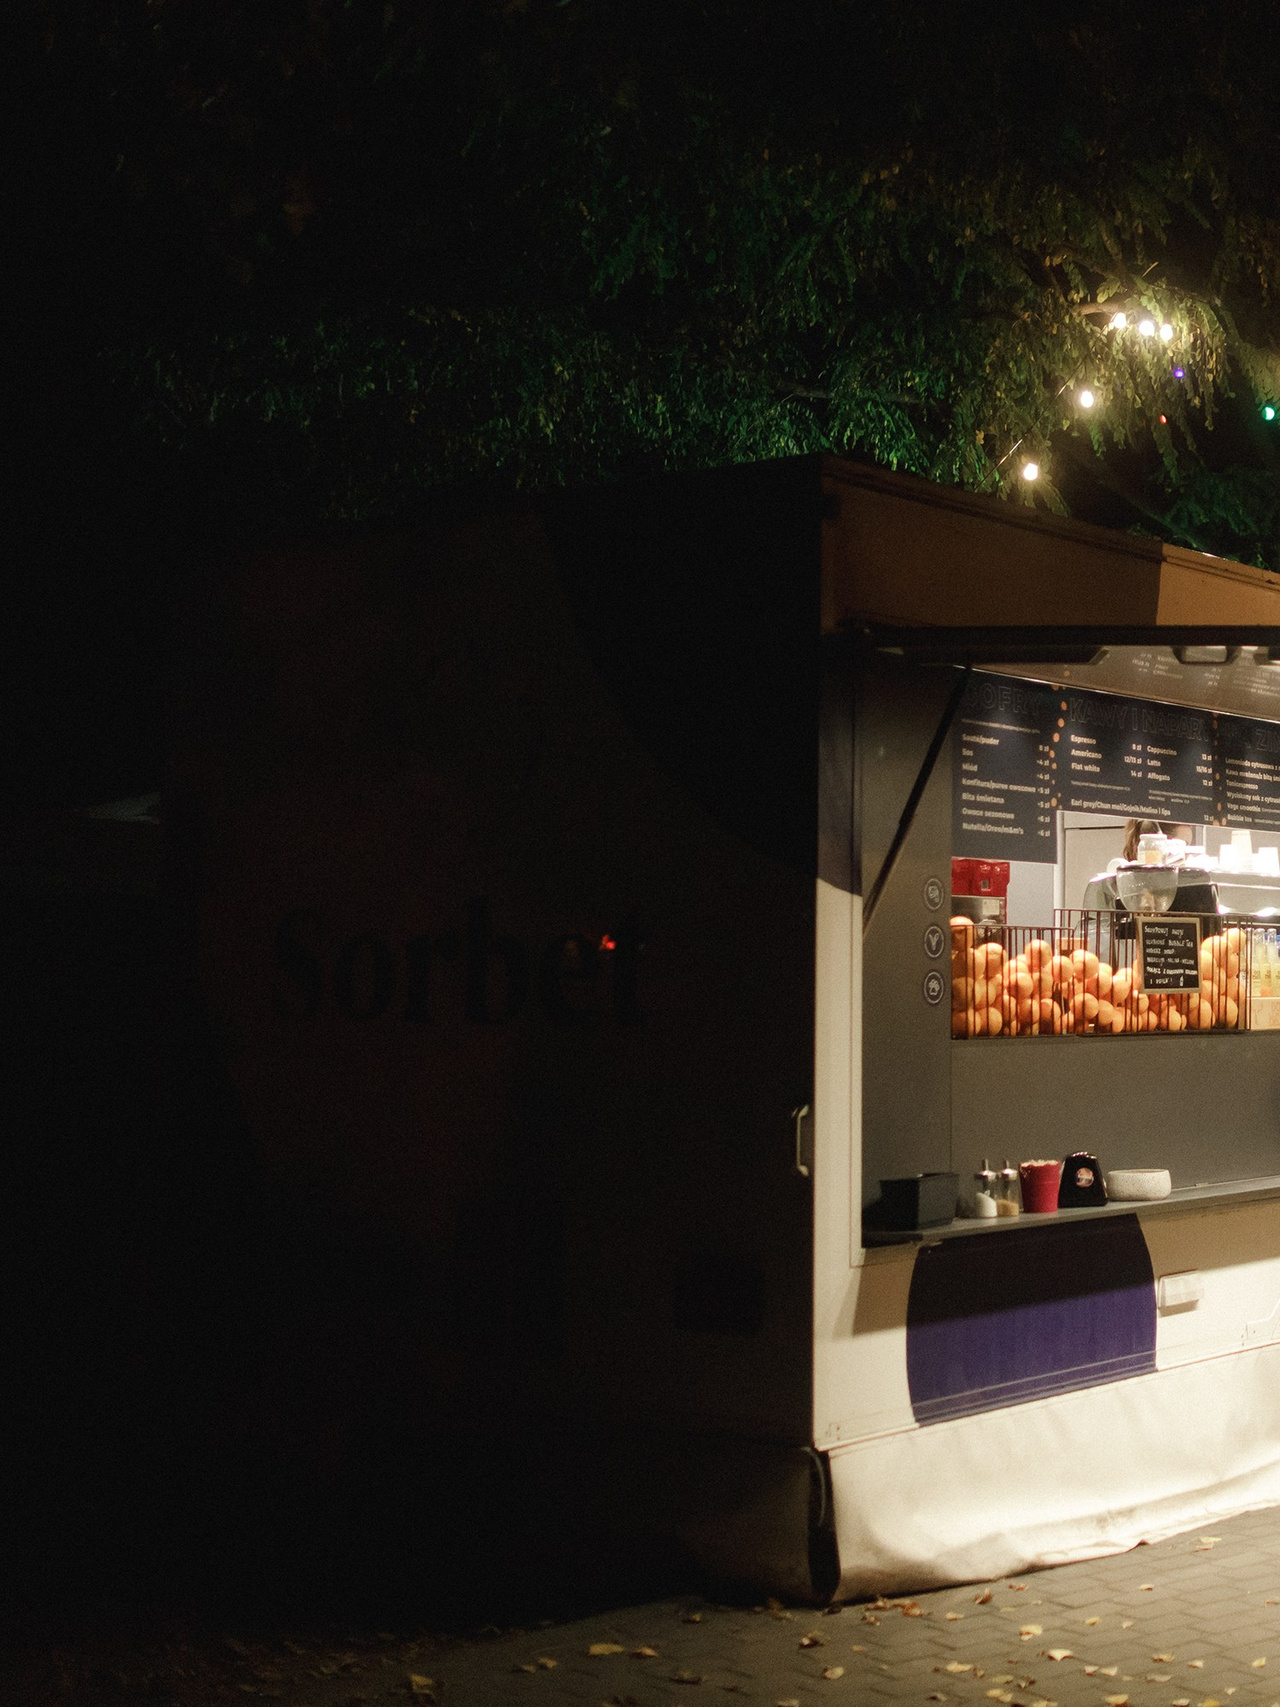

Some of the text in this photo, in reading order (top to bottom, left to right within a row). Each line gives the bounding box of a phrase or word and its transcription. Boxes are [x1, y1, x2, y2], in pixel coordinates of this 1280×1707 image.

[1071, 734, 1097, 745] Espresso
[1071, 749, 1102, 760] Americano
[275, 895, 649, 1026] Sorbet
